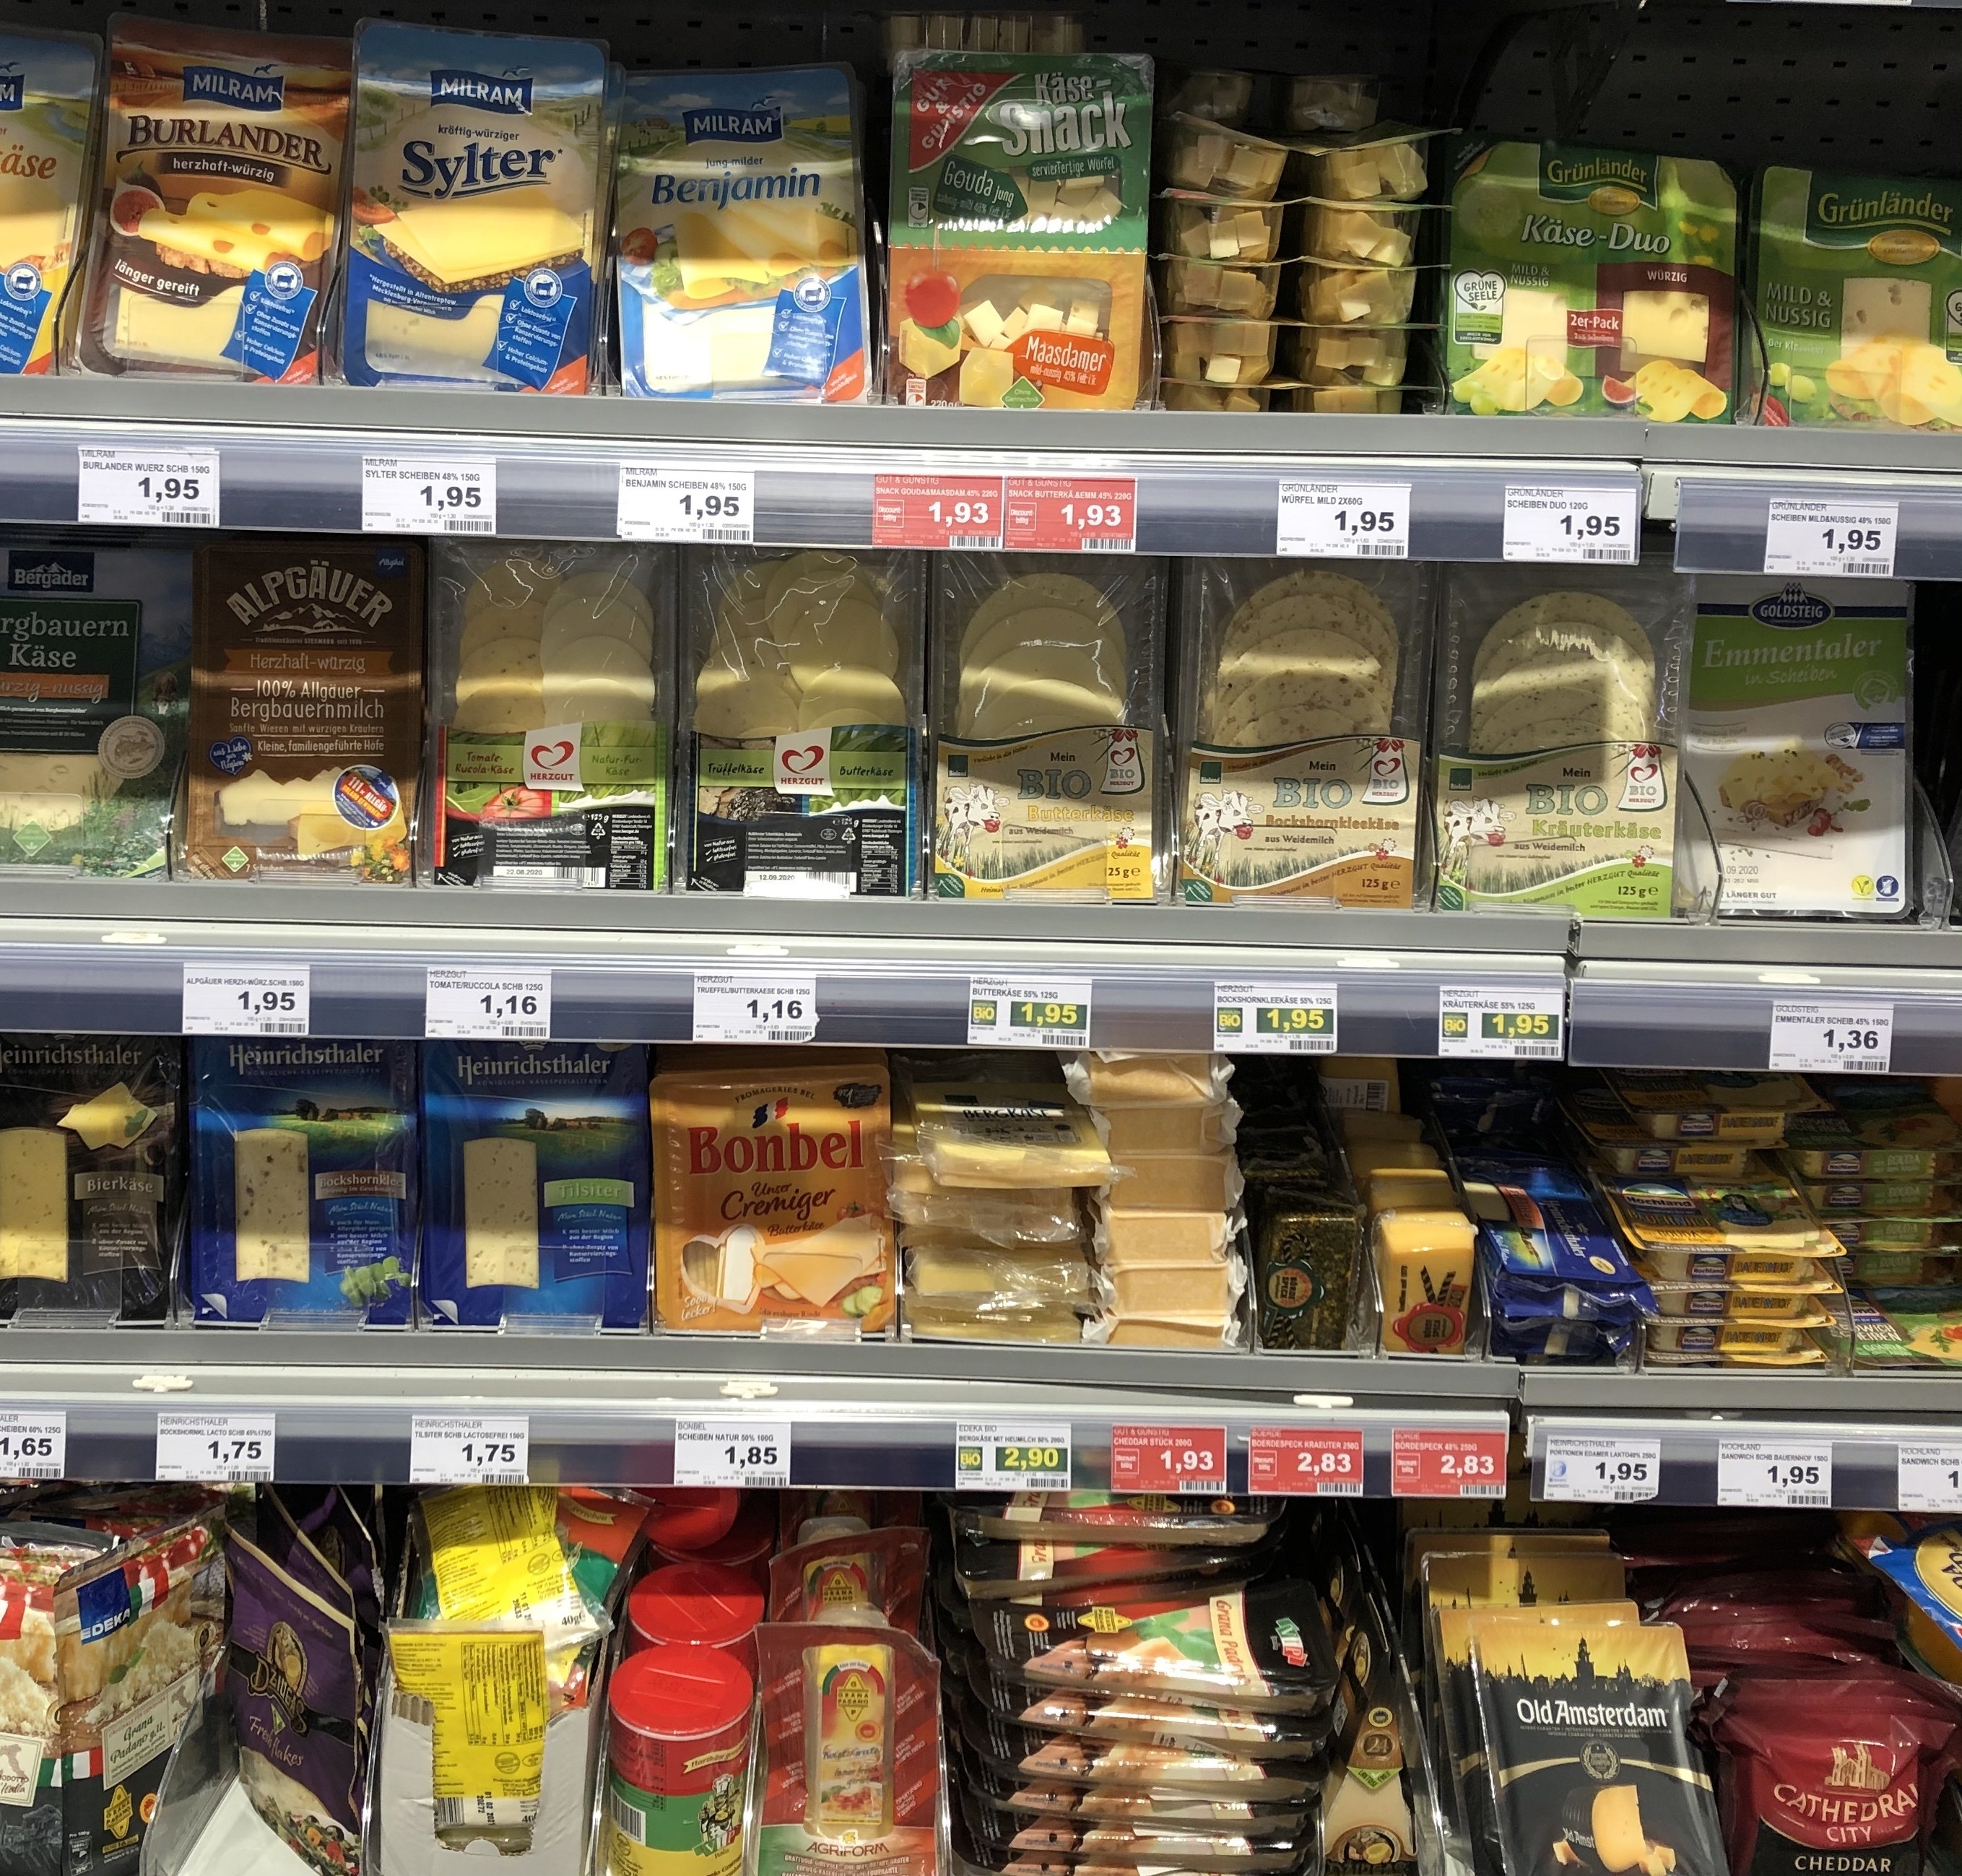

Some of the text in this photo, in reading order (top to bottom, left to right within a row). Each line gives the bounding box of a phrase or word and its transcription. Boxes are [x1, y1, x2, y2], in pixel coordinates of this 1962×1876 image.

[193, 74, 283, 103] MILRAM
[441, 77, 522, 105] MILRAM
[438, 124, 519, 142] kräftig-würziger
[694, 116, 773, 135] MILRAM
[1000, 91, 1132, 156] Snack
[129, 115, 324, 167] BURLANDER
[173, 157, 274, 183] herzhaft-würzig
[1547, 156, 1647, 183] Grünländer
[651, 168, 820, 211] Benjamin
[944, 160, 994, 197] Gouda
[993, 184, 1015, 207] jung
[1818, 190, 1953, 223] Grünländer
[114, 259, 201, 298] länger gereift
[1511, 264, 1539, 277] MILD
[1511, 274, 1550, 287] NUSSIG
[1464, 279, 1498, 292] GRÜNE
[1468, 290, 1497, 302] SEELE
[1767, 282, 1831, 308] MILD &
[1570, 313, 1619, 331] 2er-Pack
[1766, 304, 1831, 328] NUSSIG
[1025, 335, 1107, 372] Maasdamer
[82, 461, 188, 473] BURLANDER SCHB
[365, 470, 396, 479] SYLTER
[399, 471, 440, 479] SCHEIBEN
[138, 477, 199, 503] 1,95
[625, 479, 667, 488] BENJAMIN
[1009, 490, 1033, 498] SNACK
[420, 485, 481, 511] 1,95
[680, 495, 739, 520] 1,95
[1281, 495, 1363, 506] WÜRFEL MILD 2X60G
[1507, 500, 1589, 511] SCHEIBEN DUO 120G
[928, 501, 989, 527] 1,93
[1061, 503, 1121, 530] 1,93
[1334, 511, 1394, 536] 1,95
[1771, 513, 1857, 524] SCHEIBEN MILD&NUSSIG
[1560, 514, 1620, 539] 1,95
[1823, 529, 1881, 554] 1,95
[14, 567, 89, 589] Bergader
[226, 560, 394, 627] ALPGÄUER
[1760, 604, 1824, 619] GOLDSTEIG
[9, 643, 77, 669] Käse
[1701, 632, 1883, 669] Emmentaler
[251, 652, 365, 673] Herzhaft-würzig
[1768, 664, 1838, 685] Scheiben
[256, 679, 361, 702] 100% Allgäuer
[230, 697, 384, 722] Bergbauernmilch
[1050, 752, 1075, 762] Mein
[1309, 760, 1336, 772] Mein
[530, 773, 575, 781] HERZGUT
[708, 762, 765, 775] Trüffelkäse
[839, 765, 893, 777] Butterkäse
[1109, 768, 1134, 779] BIO
[1563, 767, 1591, 778] Mein
[781, 777, 824, 786] HERZGUT
[1017, 768, 1092, 800] BIO
[1372, 778, 1399, 789] BIO
[1629, 785, 1658, 796] BIO
[1272, 777, 1353, 809] BIO
[1526, 783, 1609, 816] BIO
[1027, 804, 1134, 822] Butterkäse
[1283, 835, 1334, 845] Weidemilch
[1532, 819, 1662, 839] Kräuterkäse
[1532, 842, 1586, 852] Weidemilch
[1362, 878, 1389, 890] 125 g
[1618, 886, 1646, 898] 125 g
[186, 976, 222, 986] ALPGÄUER
[429, 981, 500, 990] TOMATE/RUCCOLA
[972, 987, 1022, 997] BUTTERKÄSE
[238, 991, 296, 1015] 1,95
[479, 994, 537, 1019] 1,16
[746, 999, 803, 1022] 1,16
[1442, 999, 1499, 1009] KRÄUTERKÄSE
[1020, 1003, 1077, 1026] 1,95
[1267, 1009, 1324, 1033] 1,95
[1492, 1014, 1550, 1038] 1,95
[1823, 1029, 1878, 1052] 1,36
[229, 1044, 383, 1076] Heinrichsthaler
[457, 1054, 610, 1085] Heinrichsthaler
[735, 1085, 815, 1103] FROMAGERIES BEL
[687, 1120, 865, 1175] Bonbel
[87, 1178, 154, 1193] Bierkäse
[559, 1184, 621, 1199] Tilsiter
[751, 1181, 791, 1197] Unser
[721, 1188, 835, 1220] Cremiger
[1627, 1196, 1692, 1207] Hochland
[768, 1221, 825, 1237] Butterkäse
[160, 1417, 228, 1426] HEINRICHSTHALER
[0, 1438, 52, 1460] 1,65
[208, 1441, 262, 1463] 1,75
[1114, 1438, 1173, 1447] CHEDDAR STÜCK
[1252, 1439, 1342, 1450] BOERDESPECK KRAEUTER
[462, 1443, 516, 1467] 1,75
[725, 1446, 777, 1469] 1,85
[1004, 1447, 1059, 1469] 2,90
[1160, 1450, 1214, 1474] 1,93
[1297, 1452, 1352, 1476] 2,83
[1441, 1455, 1494, 1479] 2,83
[1595, 1462, 1648, 1484] 1,95
[1767, 1465, 1820, 1488] 1,95
[80, 1607, 131, 1641] EDEKA
[1216, 1599, 1233, 1637] Grana
[1516, 1698, 1667, 1727] Old Amsterdam
[123, 1715, 154, 1742] Grana
[110, 1737, 147, 1763] Padano
[249, 1716, 304, 1766] Freshflakes
[1826, 1826, 1872, 1843] CITY
[806, 1842, 890, 1857] AGRIFORM
[1794, 1855, 1891, 1872] CHEDDAR
